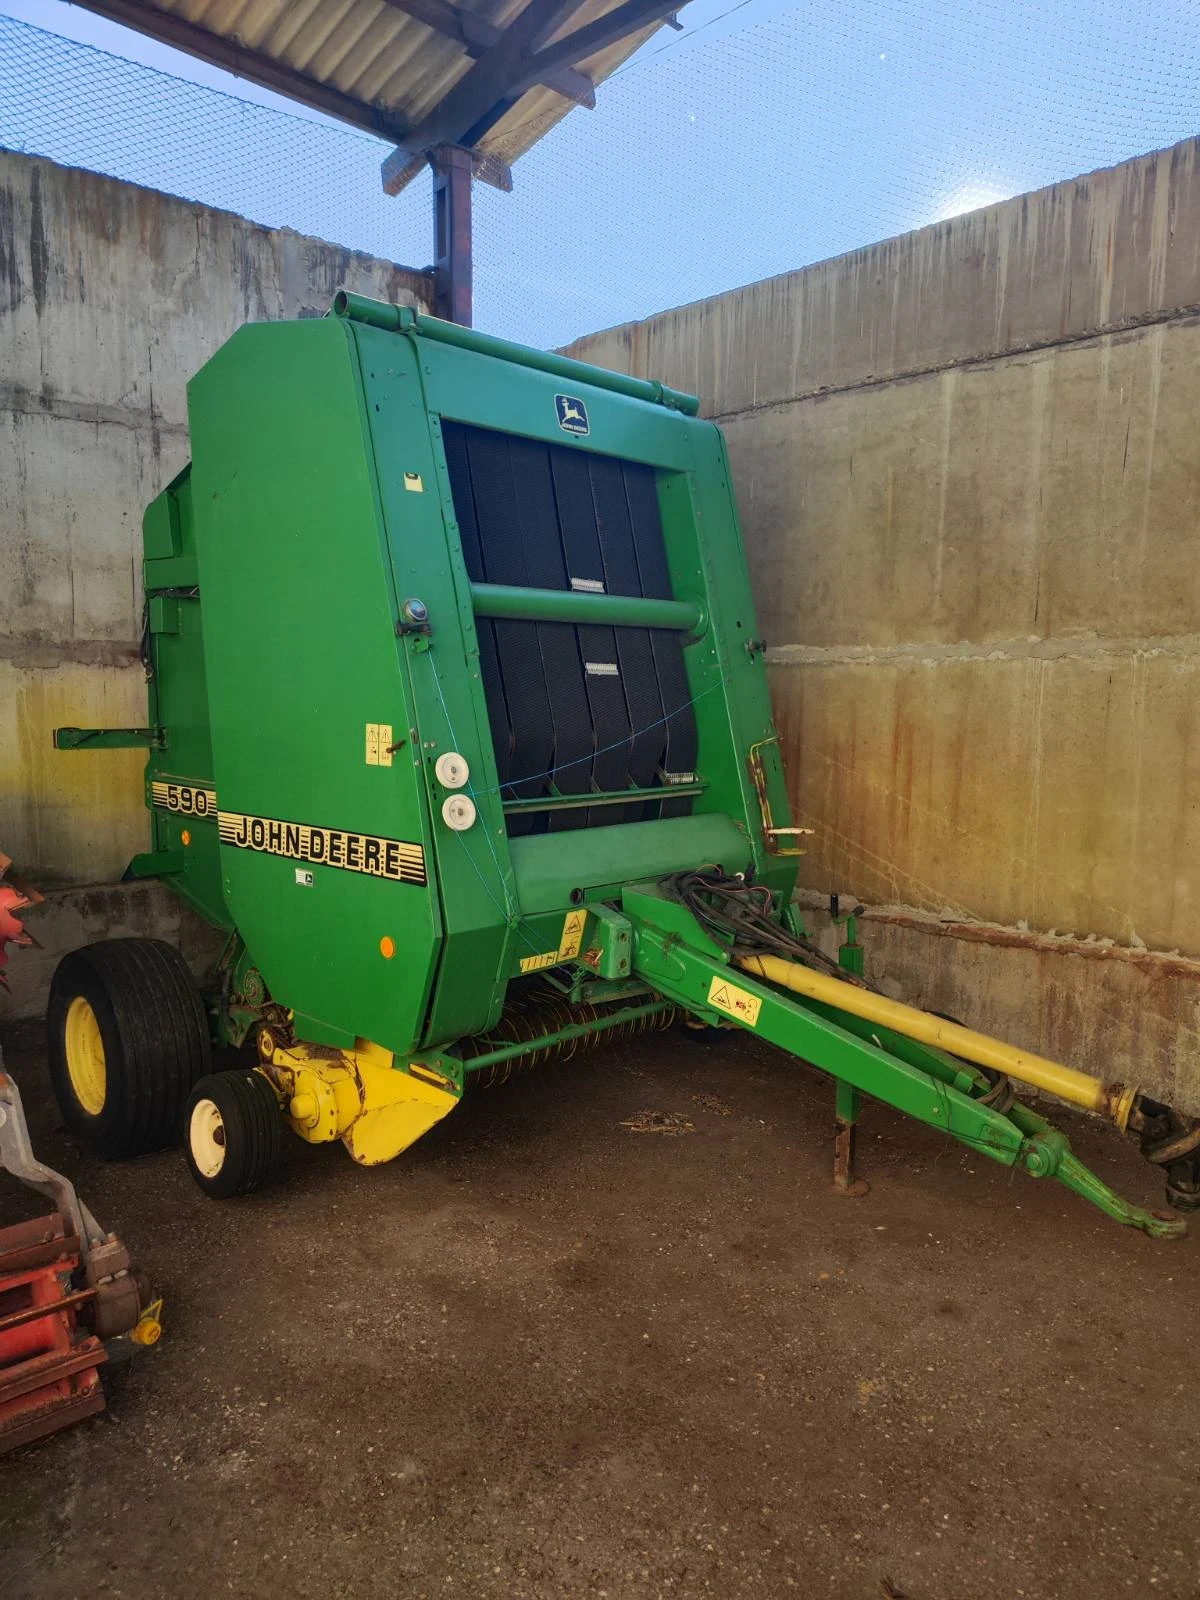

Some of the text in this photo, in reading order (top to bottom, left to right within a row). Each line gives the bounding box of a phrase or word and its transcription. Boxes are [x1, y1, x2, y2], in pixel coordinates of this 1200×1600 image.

[167, 786, 208, 814] 590
[236, 817, 400, 877] JOHN DEERE
